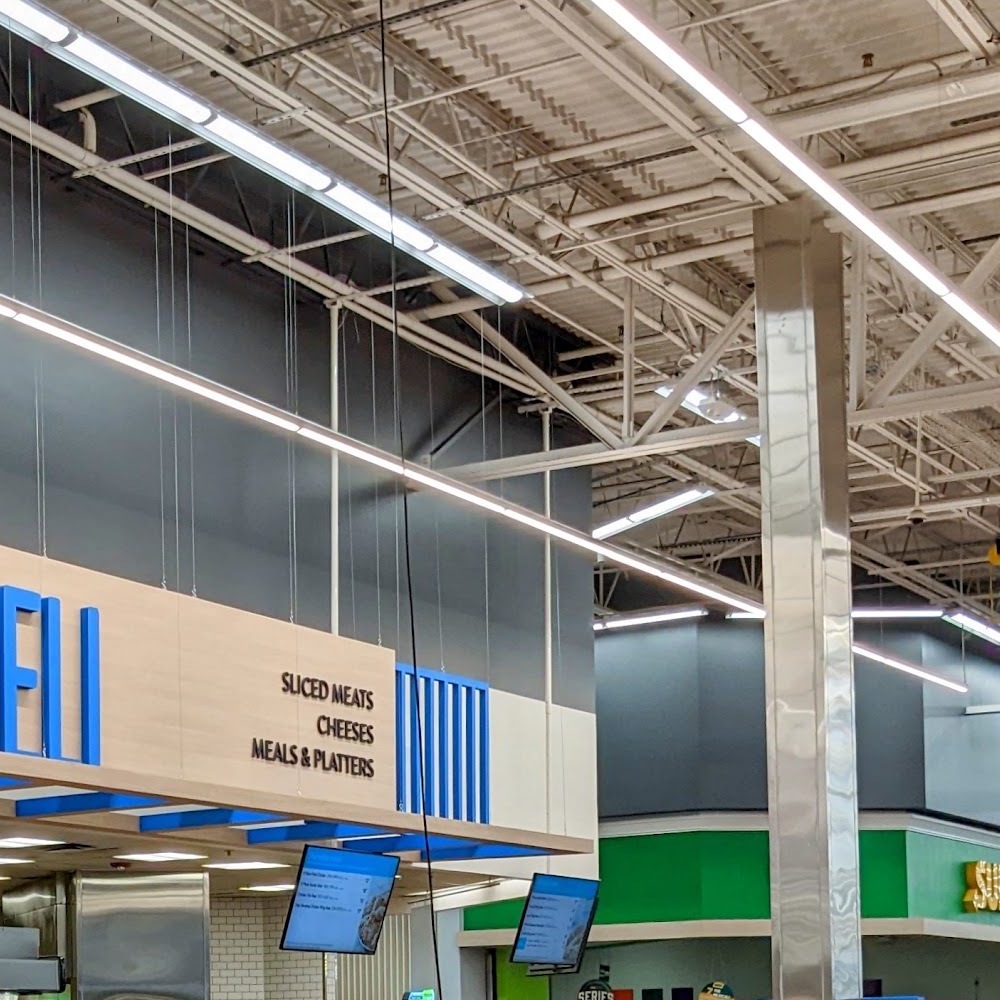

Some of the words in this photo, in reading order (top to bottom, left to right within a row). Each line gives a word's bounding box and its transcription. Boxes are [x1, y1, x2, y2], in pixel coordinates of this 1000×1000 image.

[281, 671, 329, 700] SLICED
[332, 683, 374, 710] MEATS
[317, 714, 374, 744] CHEESES
[251, 737, 298, 765] MEALS
[301, 746, 311, 768] &
[313, 748, 374, 778] PLATTERS
[963, 860, 1000, 912] SU
